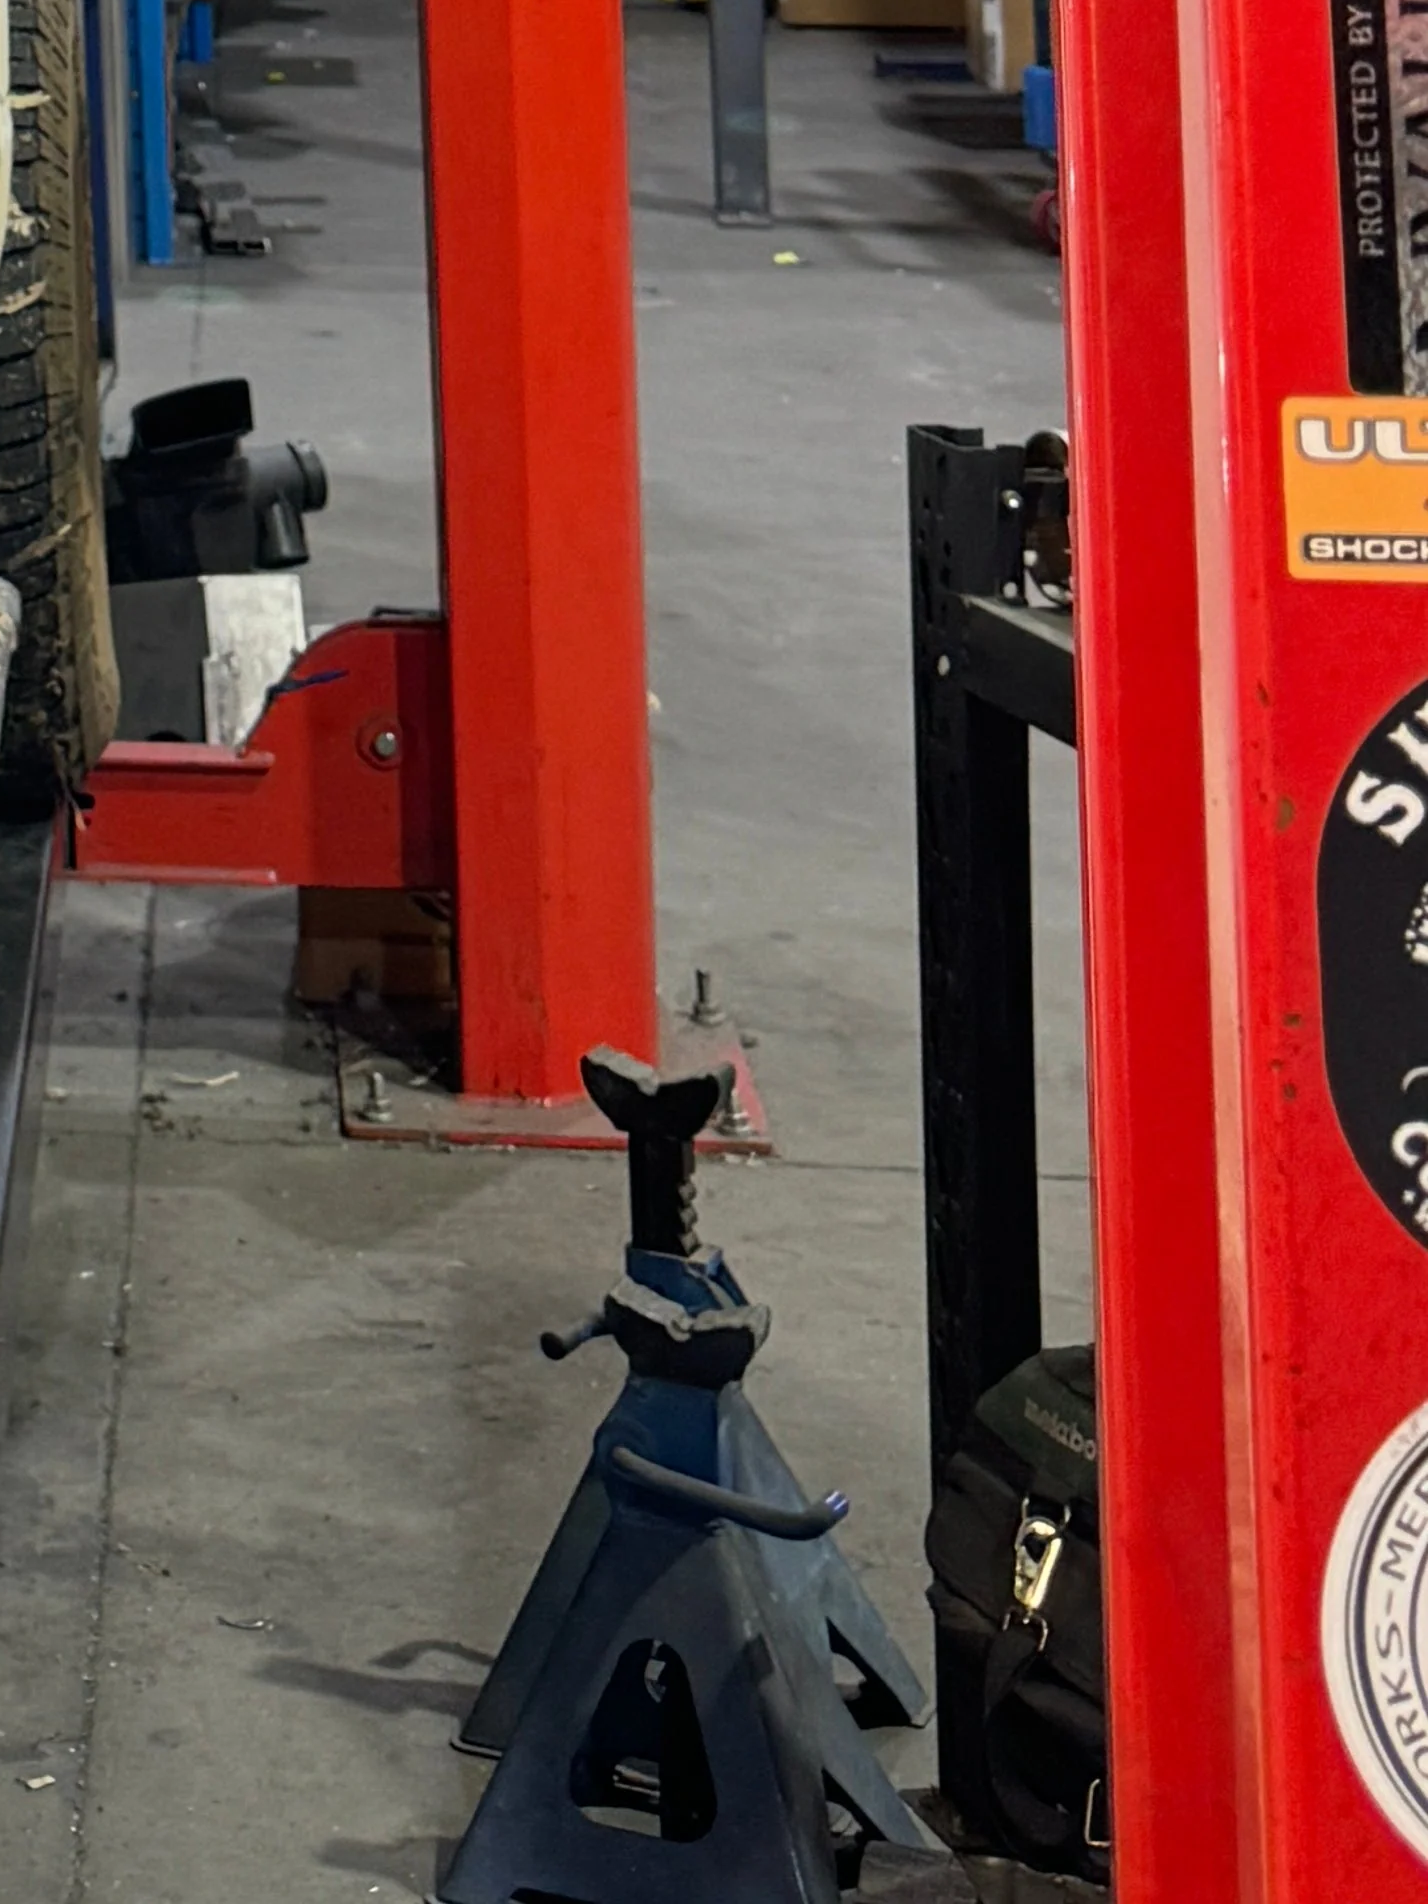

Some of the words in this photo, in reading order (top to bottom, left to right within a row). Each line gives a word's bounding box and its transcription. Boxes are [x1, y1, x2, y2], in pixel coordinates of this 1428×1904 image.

[1347, 3, 1375, 47] BY
[1350, 60, 1386, 259] PROTECTED
[1296, 416, 1428, 463] UL
[1024, 1396, 1096, 1462] metabo
